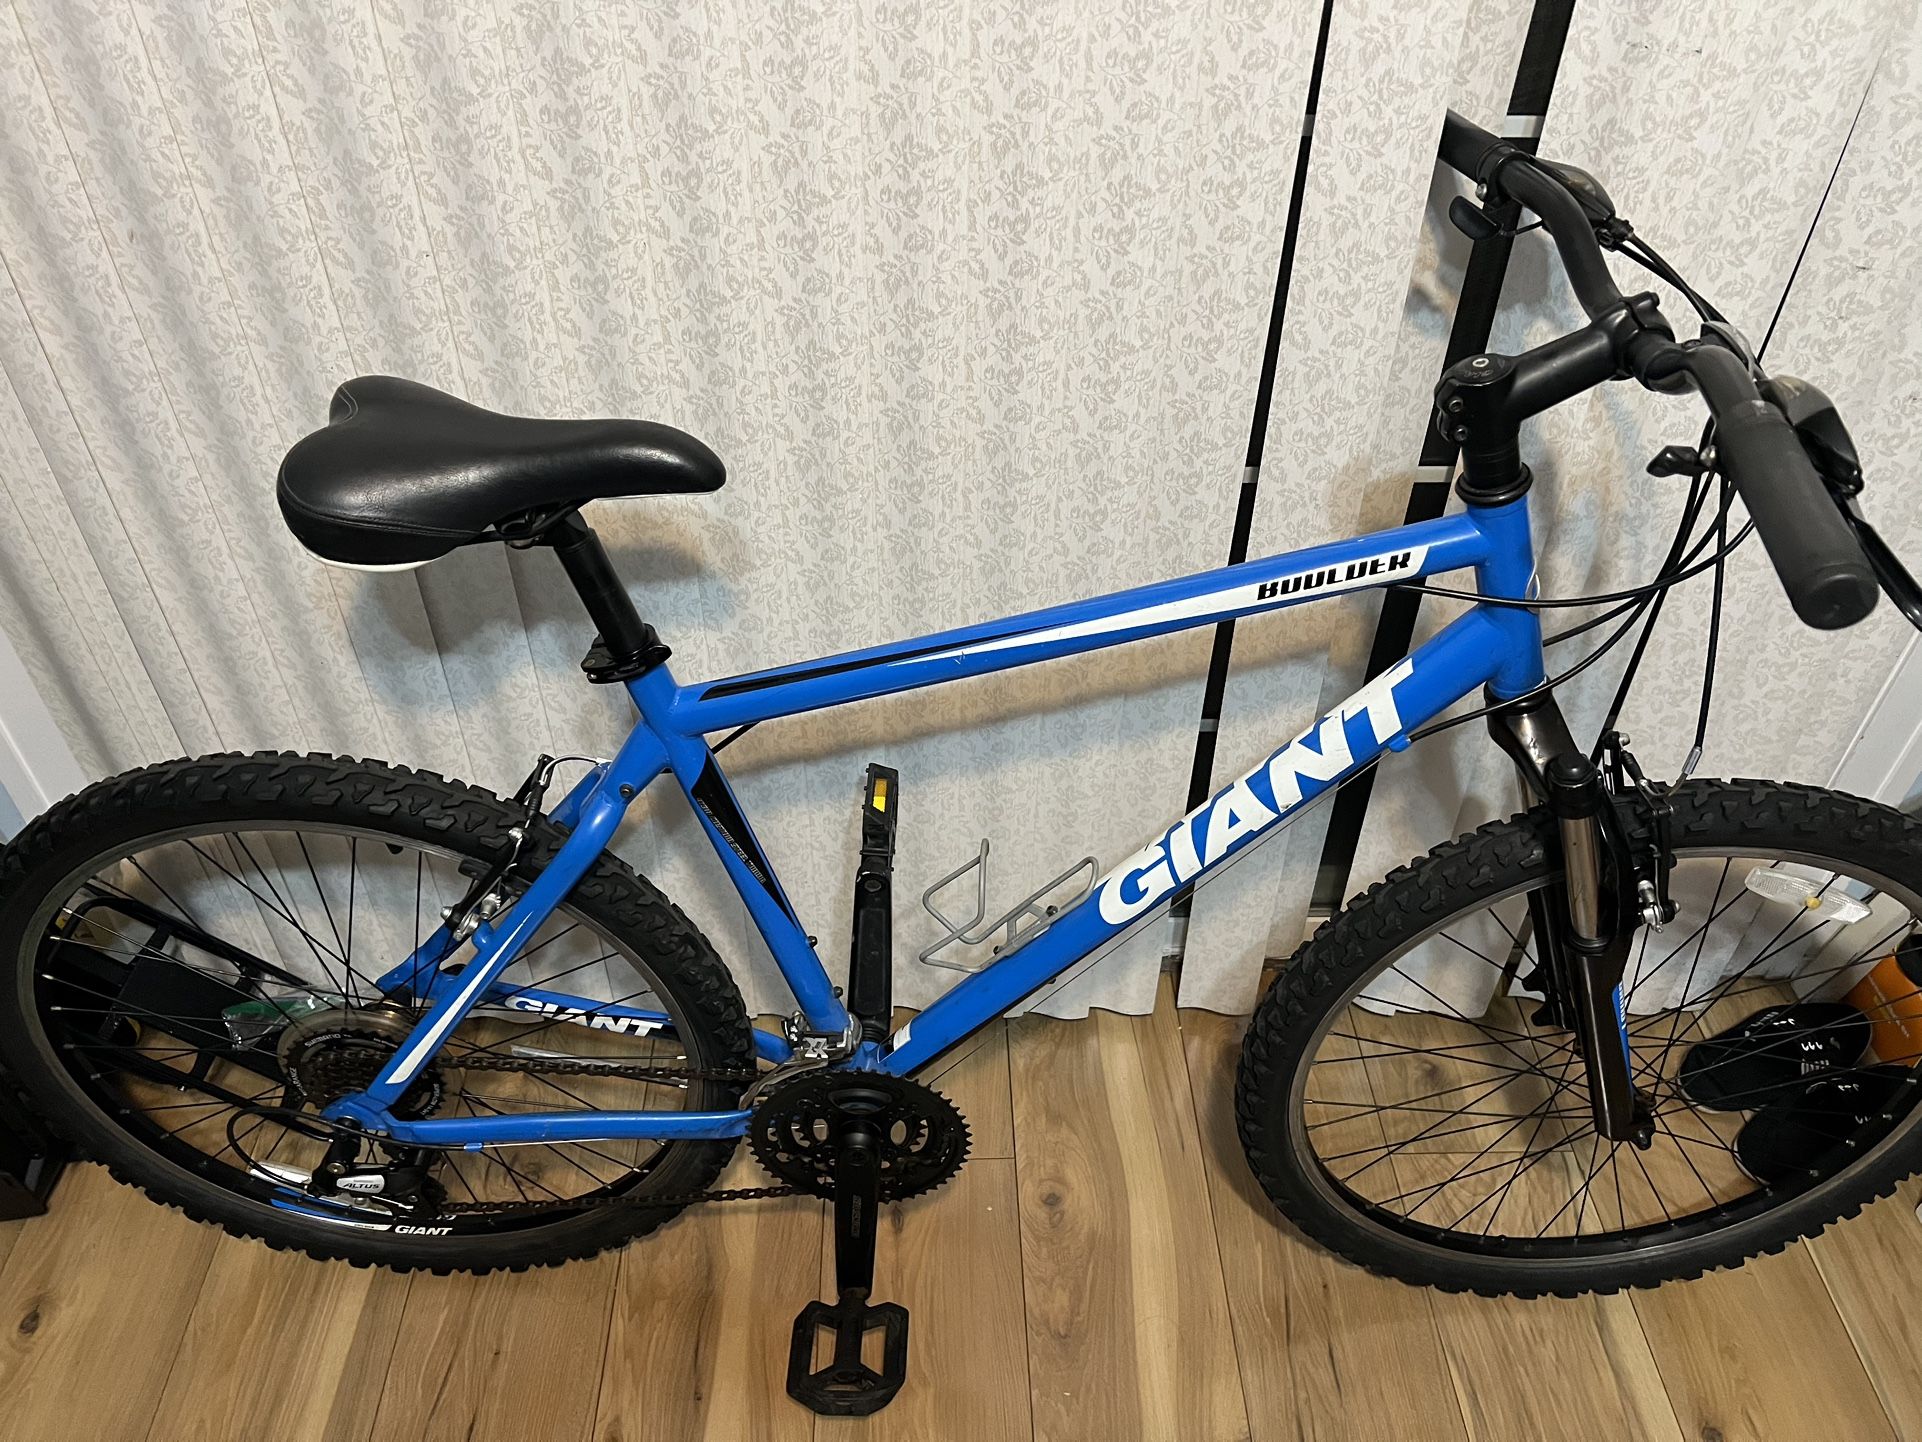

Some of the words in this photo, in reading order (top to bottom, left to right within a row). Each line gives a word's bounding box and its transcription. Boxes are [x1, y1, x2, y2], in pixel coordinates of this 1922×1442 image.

[1099, 658, 1414, 925] GIANT
[504, 996, 664, 1037] GIANT
[394, 1225, 453, 1236] GIANT
